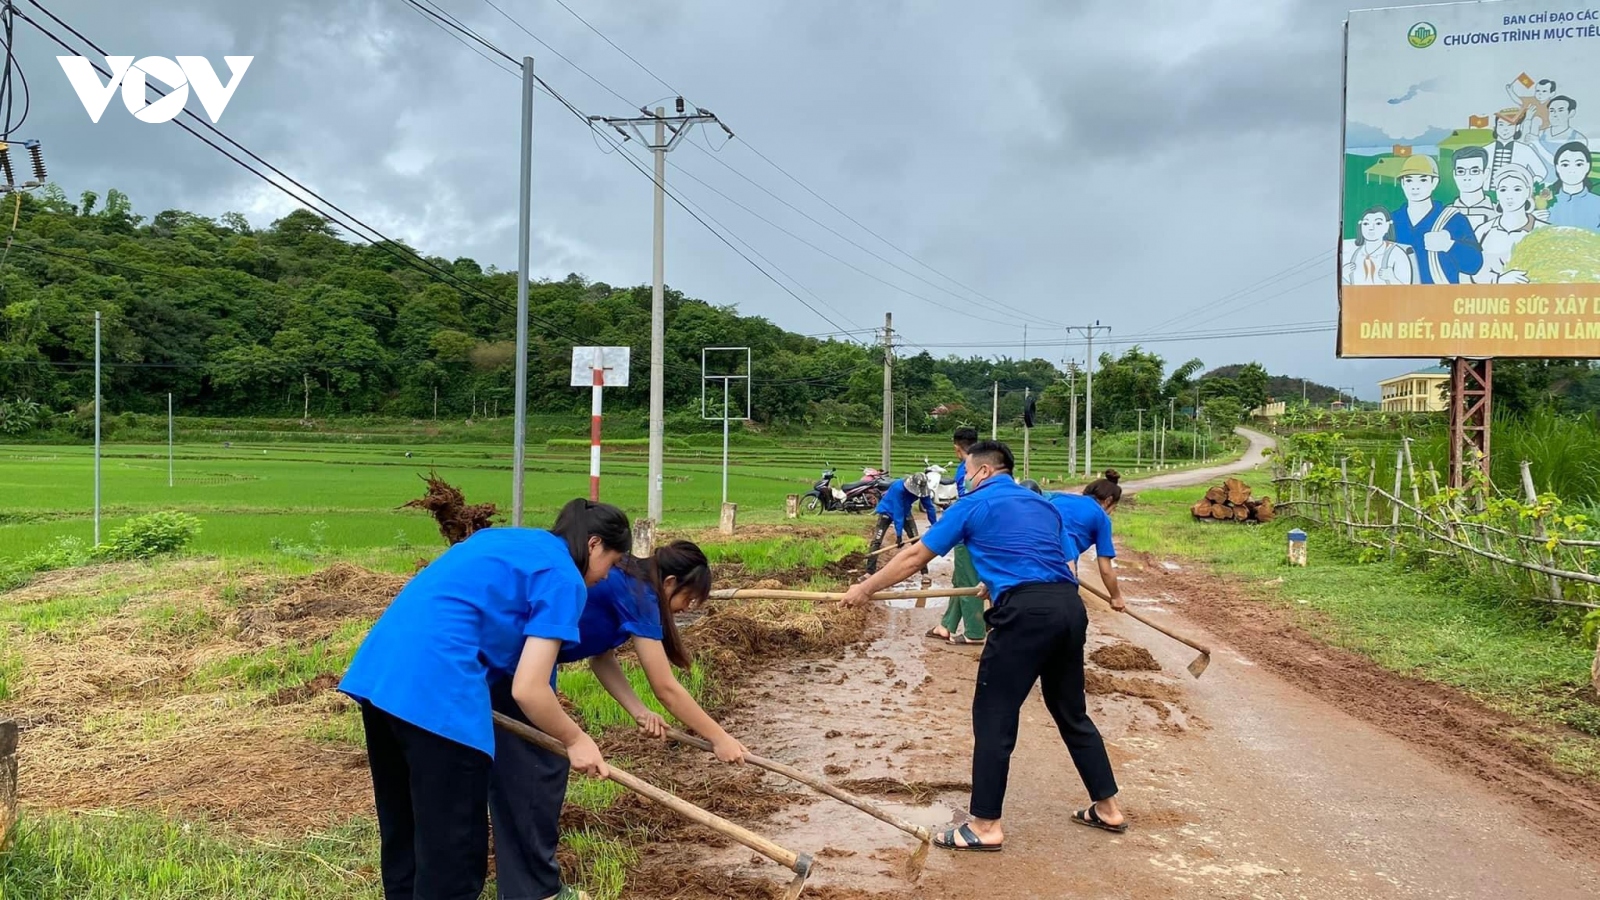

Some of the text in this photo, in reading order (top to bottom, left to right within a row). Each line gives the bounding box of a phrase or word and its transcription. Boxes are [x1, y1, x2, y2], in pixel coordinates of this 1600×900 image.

[1503, 15, 1526, 25] BAN
[1549, 12, 1574, 24] ĐẠO
[1576, 8, 1599, 20] CÁC
[1443, 32, 1499, 46] CHƯƠNG
[1502, 29, 1540, 42] TRÌNH
[1543, 27, 1574, 41] MỤC
[1453, 297, 1510, 314] CHUNG
[1515, 294, 1550, 315] SỨC
[1553, 293, 1588, 314] XÂY
[1360, 316, 1600, 341] DÂN BIẾT, DÂN BÀN, DÂN LÀM
